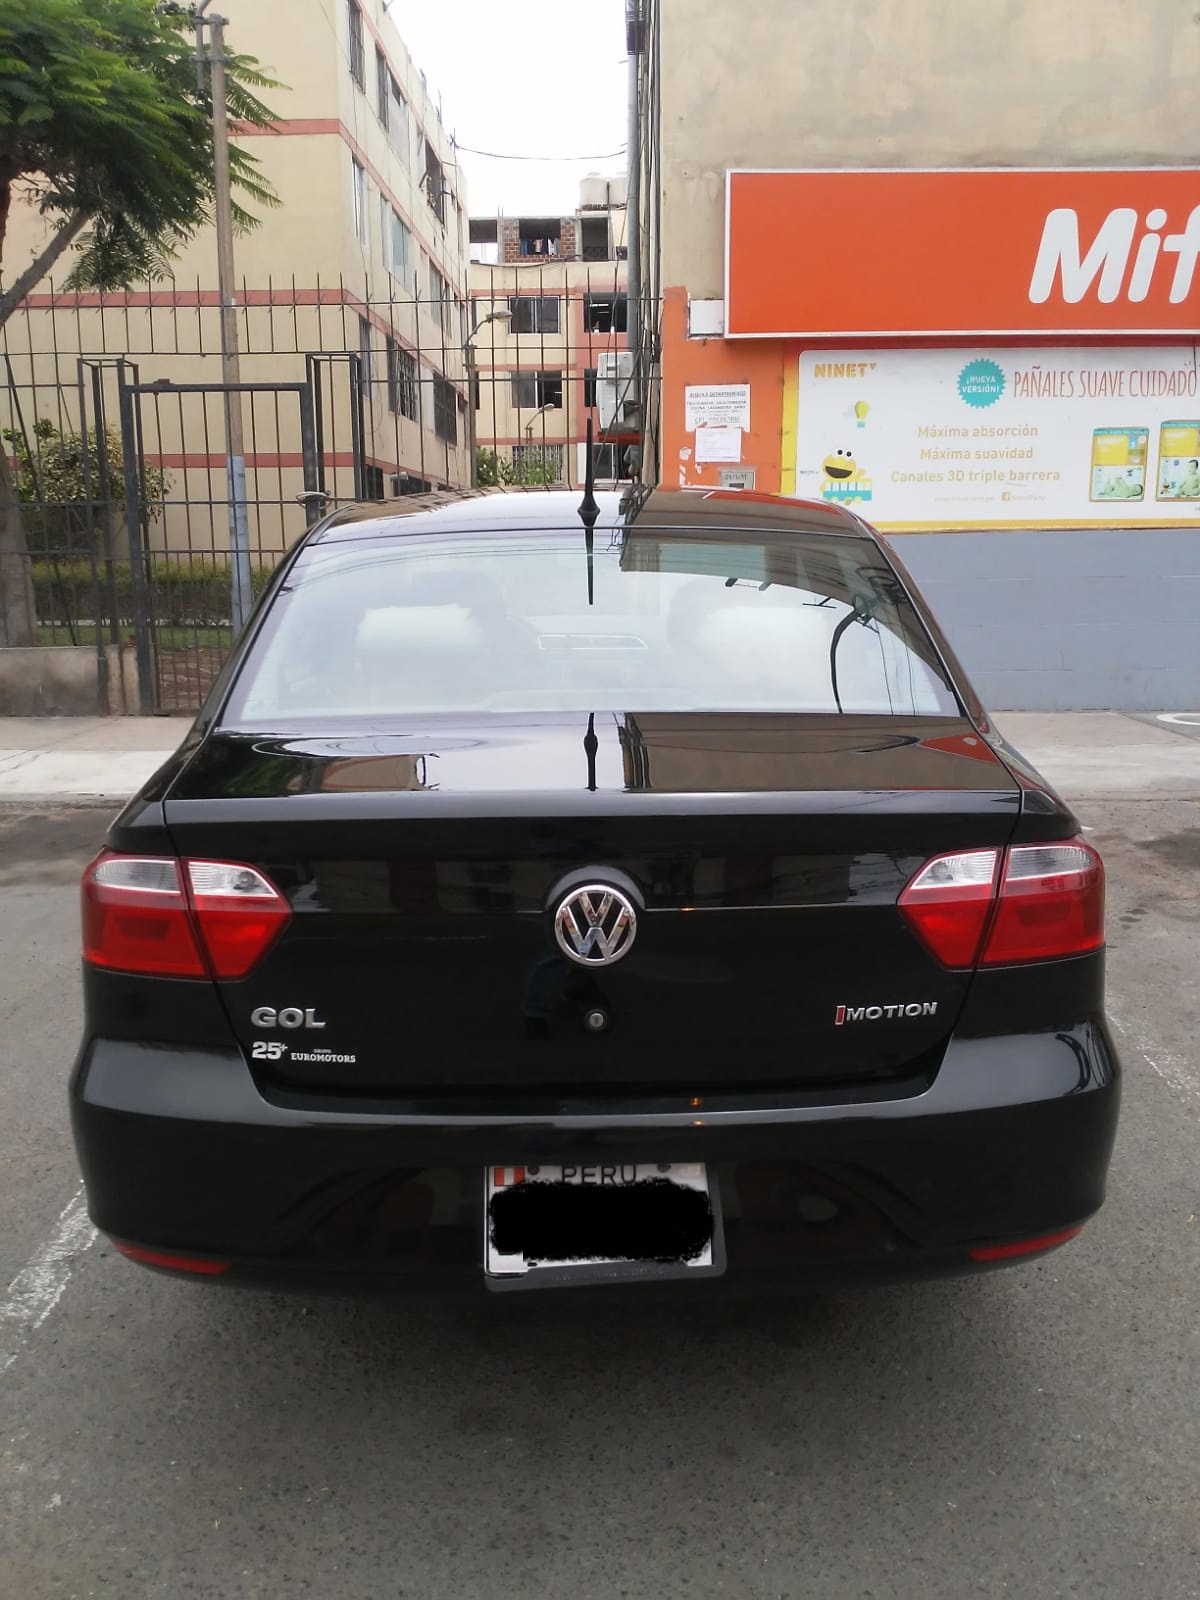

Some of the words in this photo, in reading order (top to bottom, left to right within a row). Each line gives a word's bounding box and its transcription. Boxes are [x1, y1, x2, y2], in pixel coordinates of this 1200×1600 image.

[962, 384, 999, 393] VERSIÓN!
[1013, 366, 1074, 398] PAÑALES
[1079, 370, 1125, 398] SUAVE
[1129, 369, 1197, 397] CUIDADO
[918, 424, 969, 438] Máxima
[972, 424, 1038, 437] absorción
[920, 447, 971, 460] Máxima
[975, 447, 1033, 460] suavidad
[890, 470, 944, 483] Canales
[947, 470, 965, 482] 3D
[969, 469, 1005, 484] triple
[1009, 469, 1061, 481] barrera
[250, 1006, 326, 1029] GOL
[290, 1052, 356, 1063] EUROMOTORS
[561, 1164, 637, 1185] PERU
